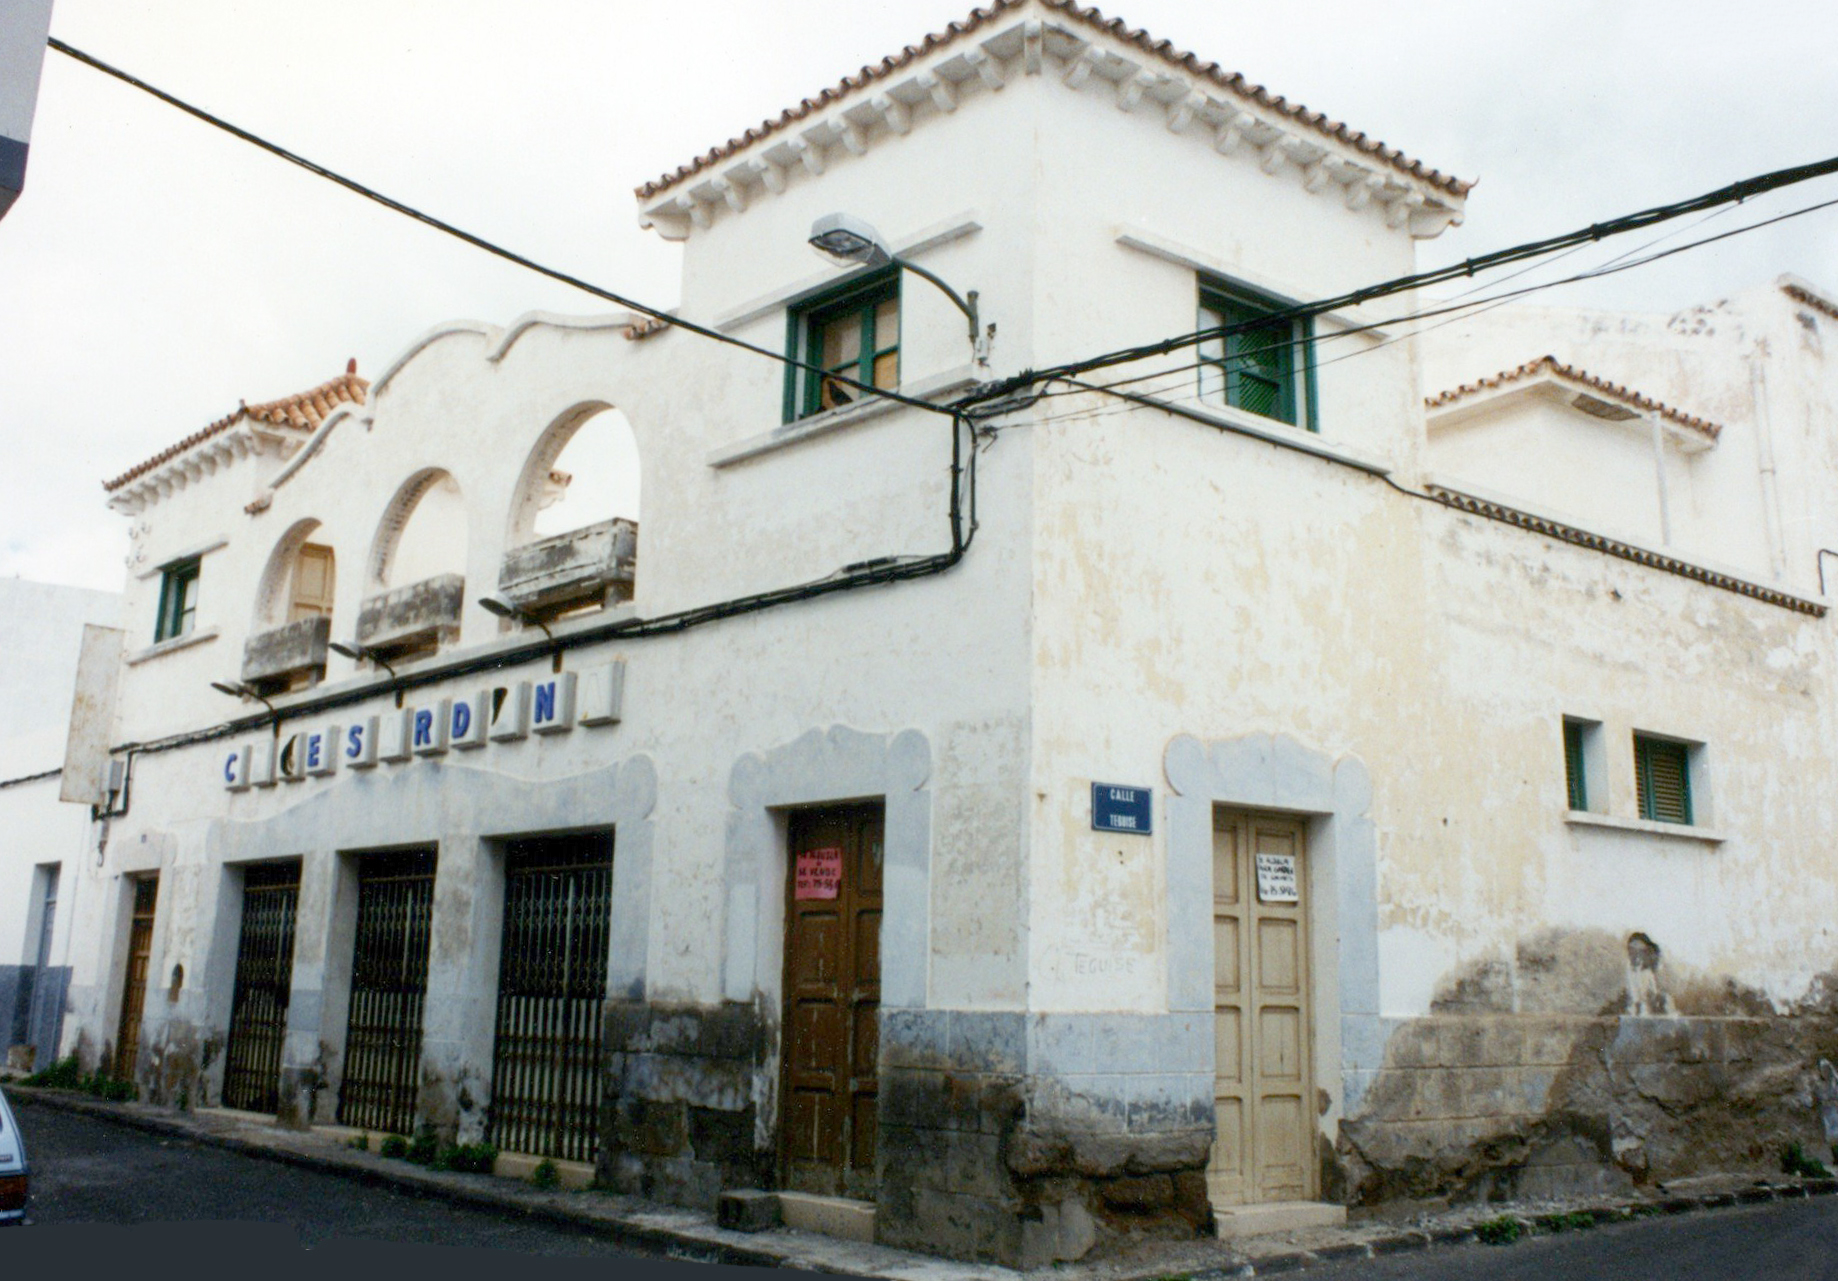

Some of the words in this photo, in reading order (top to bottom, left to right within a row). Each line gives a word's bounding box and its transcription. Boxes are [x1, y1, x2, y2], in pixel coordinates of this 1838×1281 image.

[224, 733, 322, 783] CE
[1109, 788, 1135, 803] CALLE
[1109, 814, 1137, 829] TEGUISE
